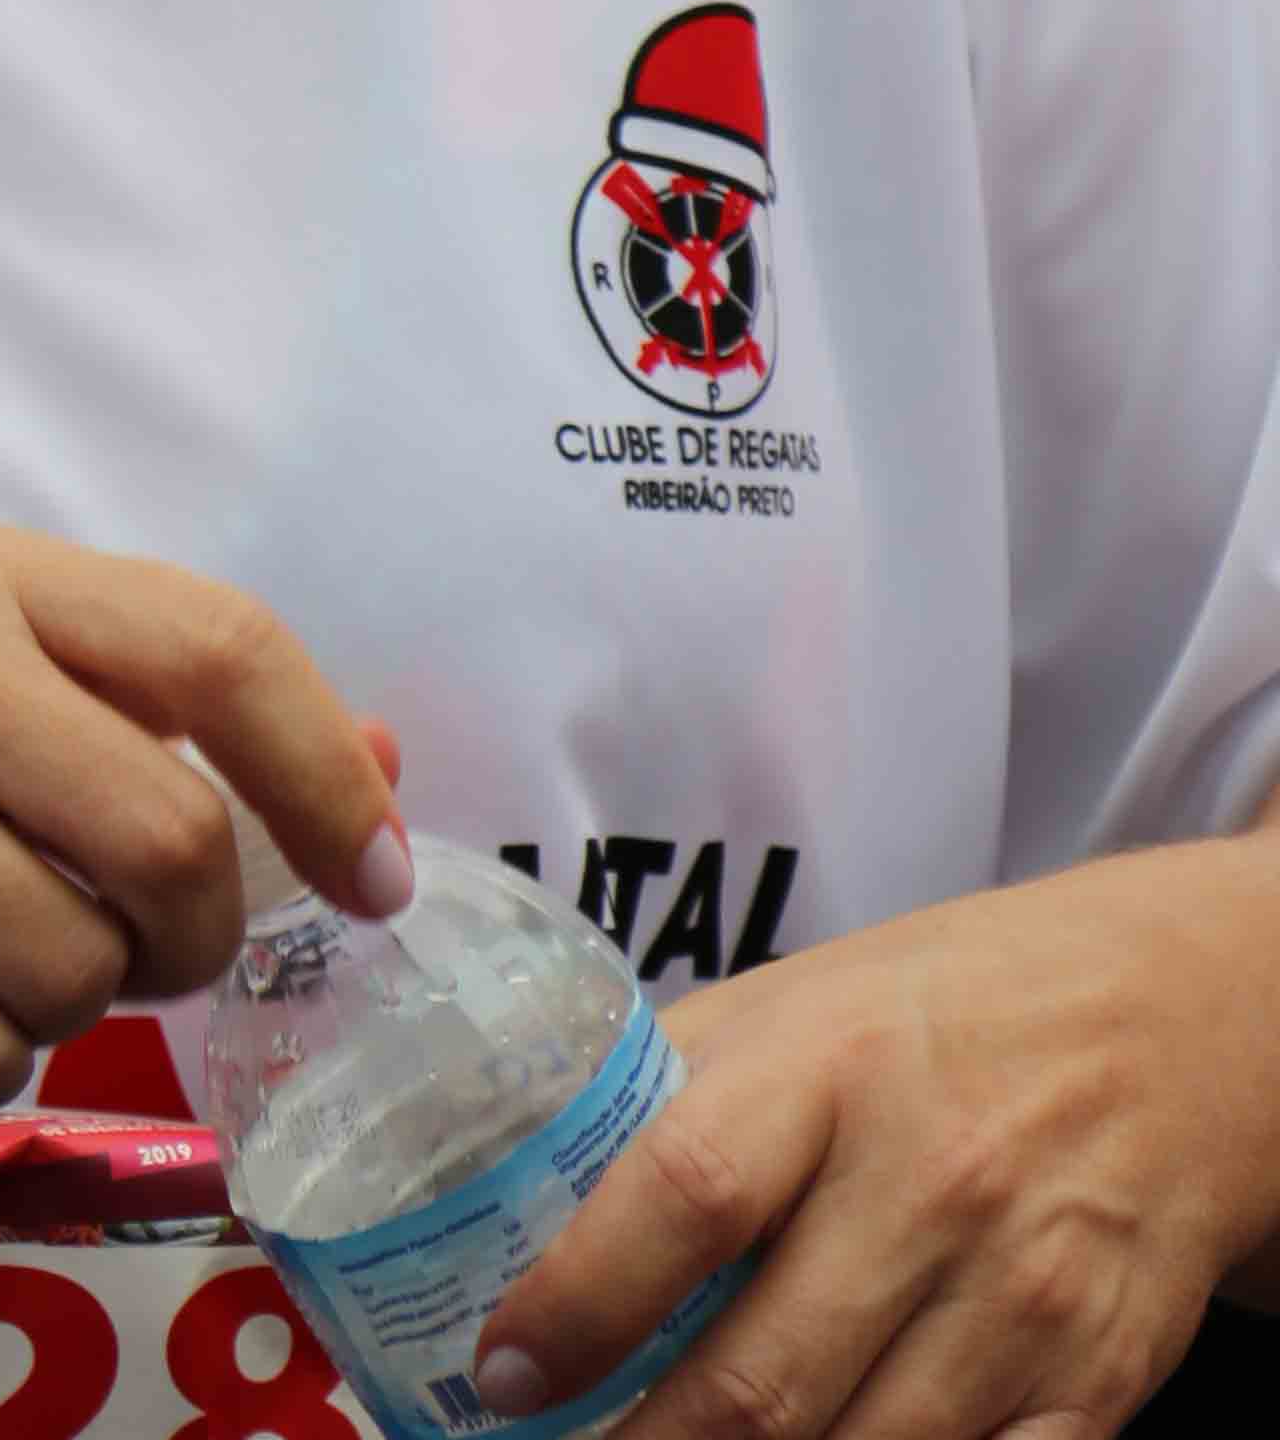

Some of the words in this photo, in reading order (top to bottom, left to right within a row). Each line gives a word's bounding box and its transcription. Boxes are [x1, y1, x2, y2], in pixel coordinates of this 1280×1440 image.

[555, 423, 667, 465] CLUBE
[676, 426, 719, 467] DE
[728, 428, 821, 472] REGATAS
[624, 475, 730, 515] RIBEIRÃO
[737, 483, 794, 517] PRETO
[498, 835, 801, 982] ATAL
[137, 1141, 193, 1167] 2019
